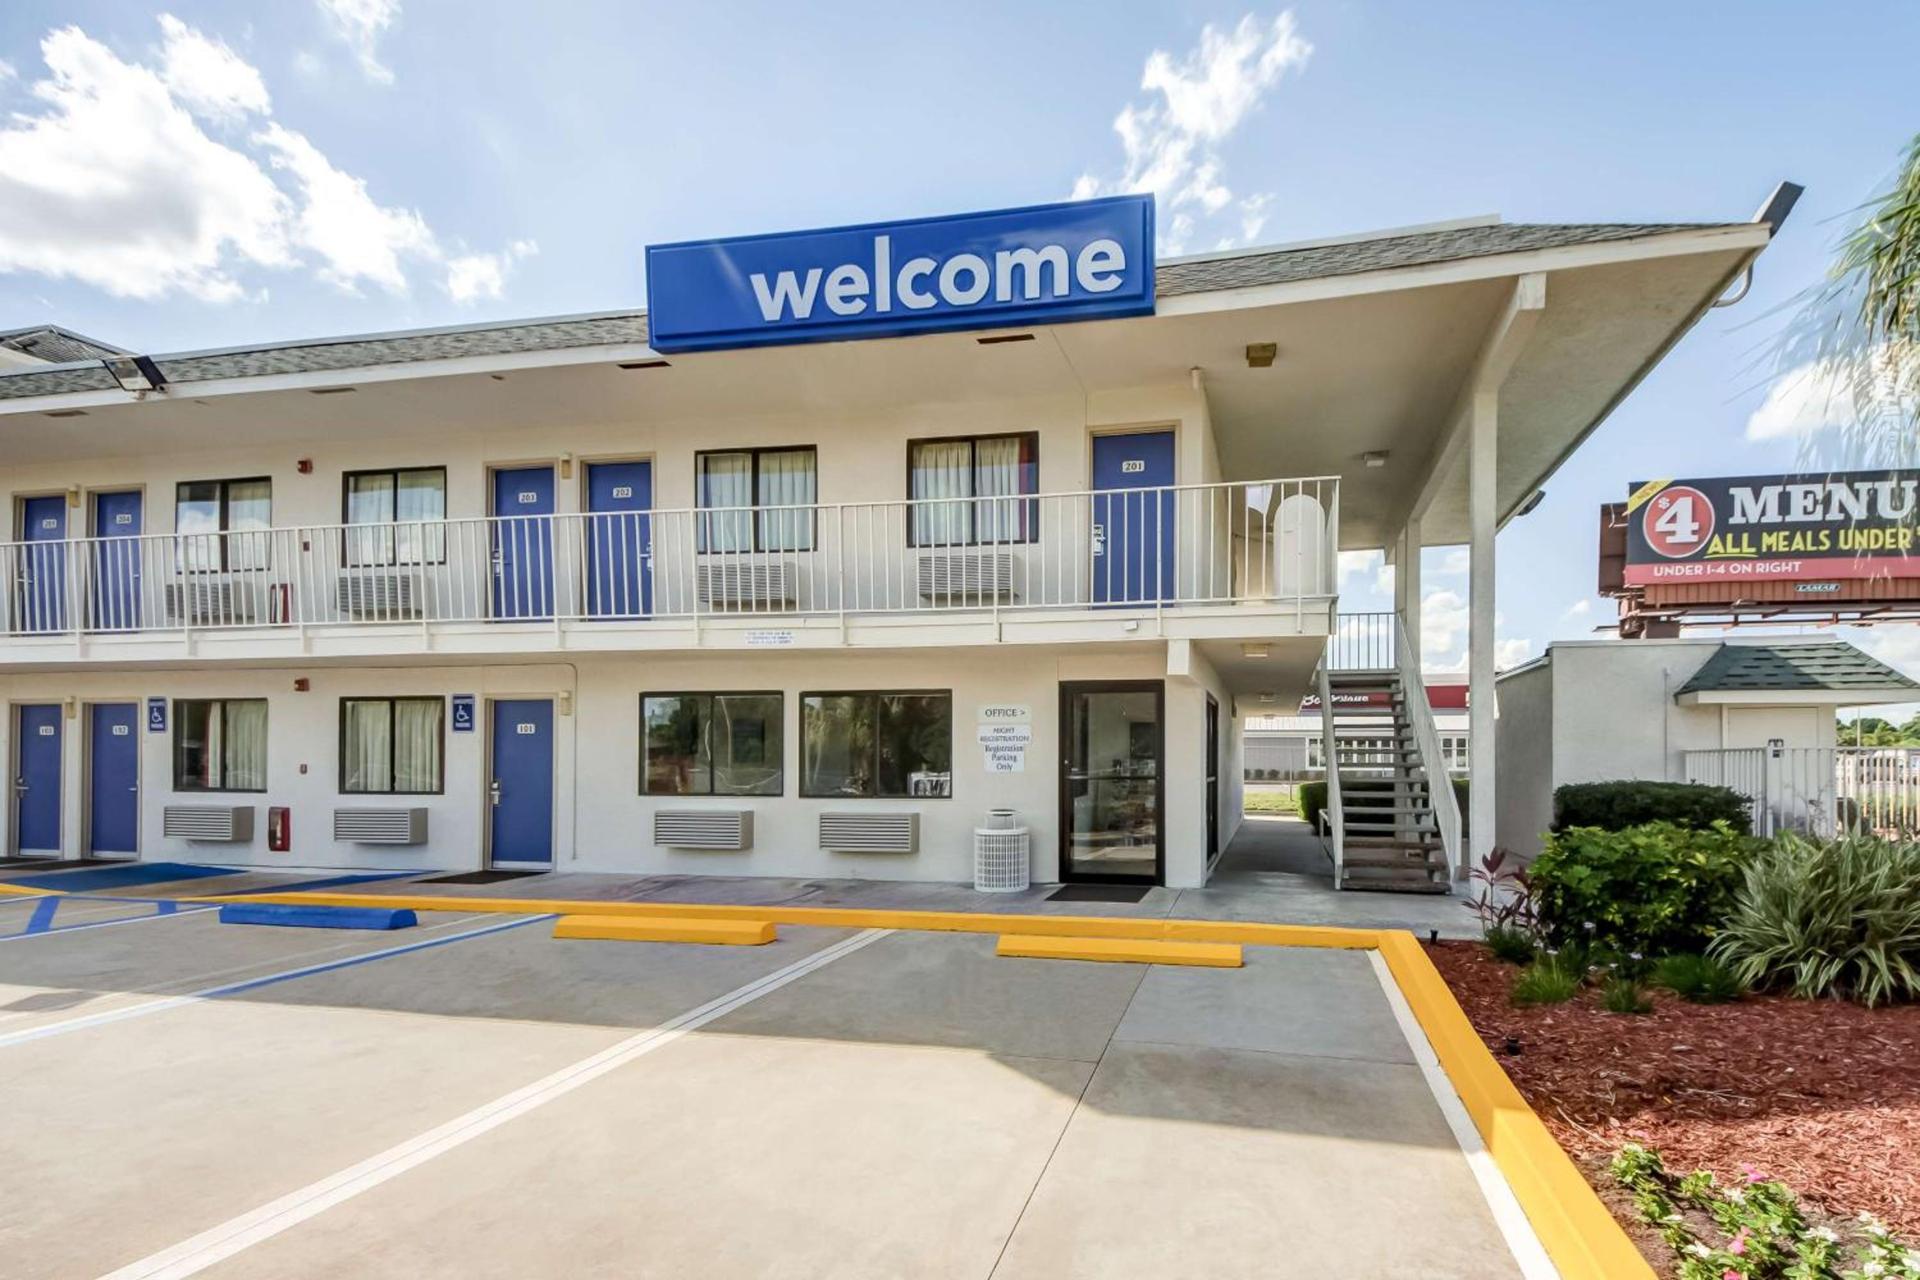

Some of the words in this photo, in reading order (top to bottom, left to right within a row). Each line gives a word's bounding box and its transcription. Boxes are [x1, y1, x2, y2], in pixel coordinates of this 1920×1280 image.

[750, 235, 1126, 321] welcome
[1124, 463, 1142, 471] 201
[1728, 480, 1918, 525] MENU
[1655, 496, 1700, 544] $4
[1706, 533, 1758, 554] ALL
[1762, 529, 1831, 553] MEALS
[1838, 528, 1912, 550] UNDER
[1653, 564, 1703, 577] UNDER
[1706, 564, 1725, 575] I-4
[1729, 563, 1752, 574] ON
[1755, 562, 1802, 573] RIGHT
[984, 708, 1017, 717] OFFICE
[984, 745, 1024, 754] Registration
[991, 754, 1017, 763] Parking
[996, 763, 1014, 772] Only
